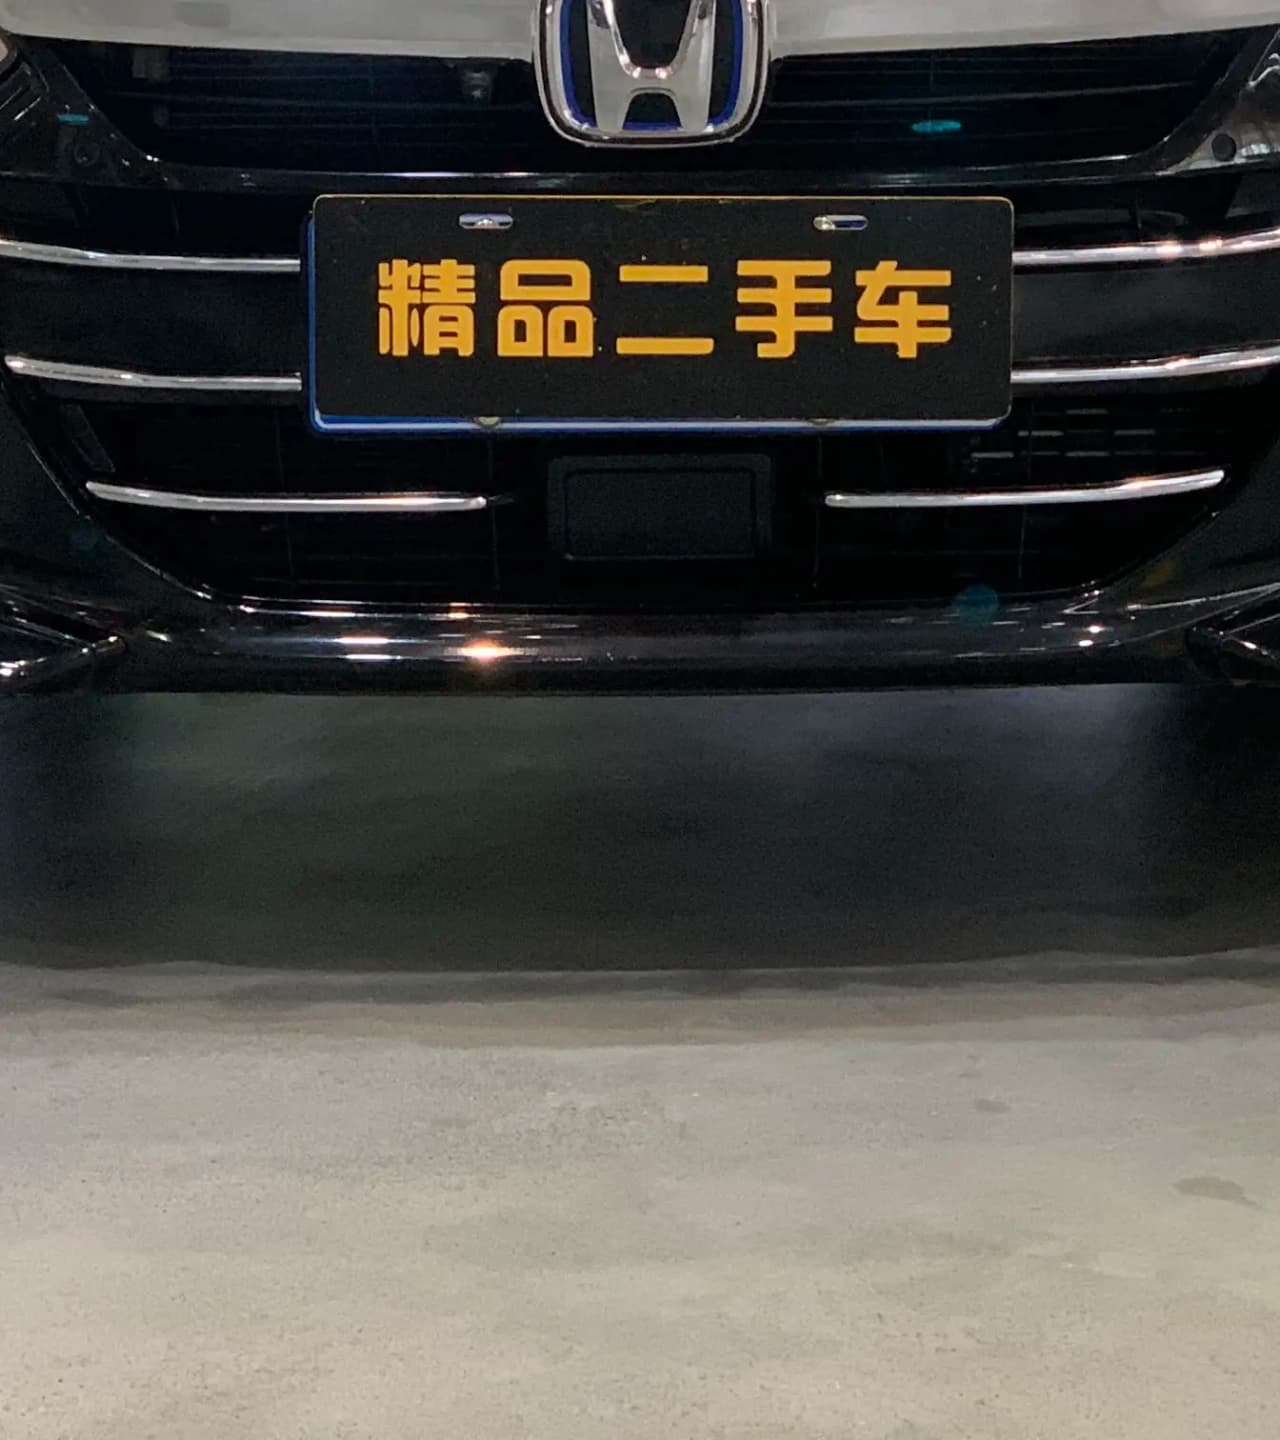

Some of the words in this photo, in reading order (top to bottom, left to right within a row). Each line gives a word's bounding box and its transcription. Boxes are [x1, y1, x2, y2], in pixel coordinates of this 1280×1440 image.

[376, 258, 954, 359] 精品二手车
